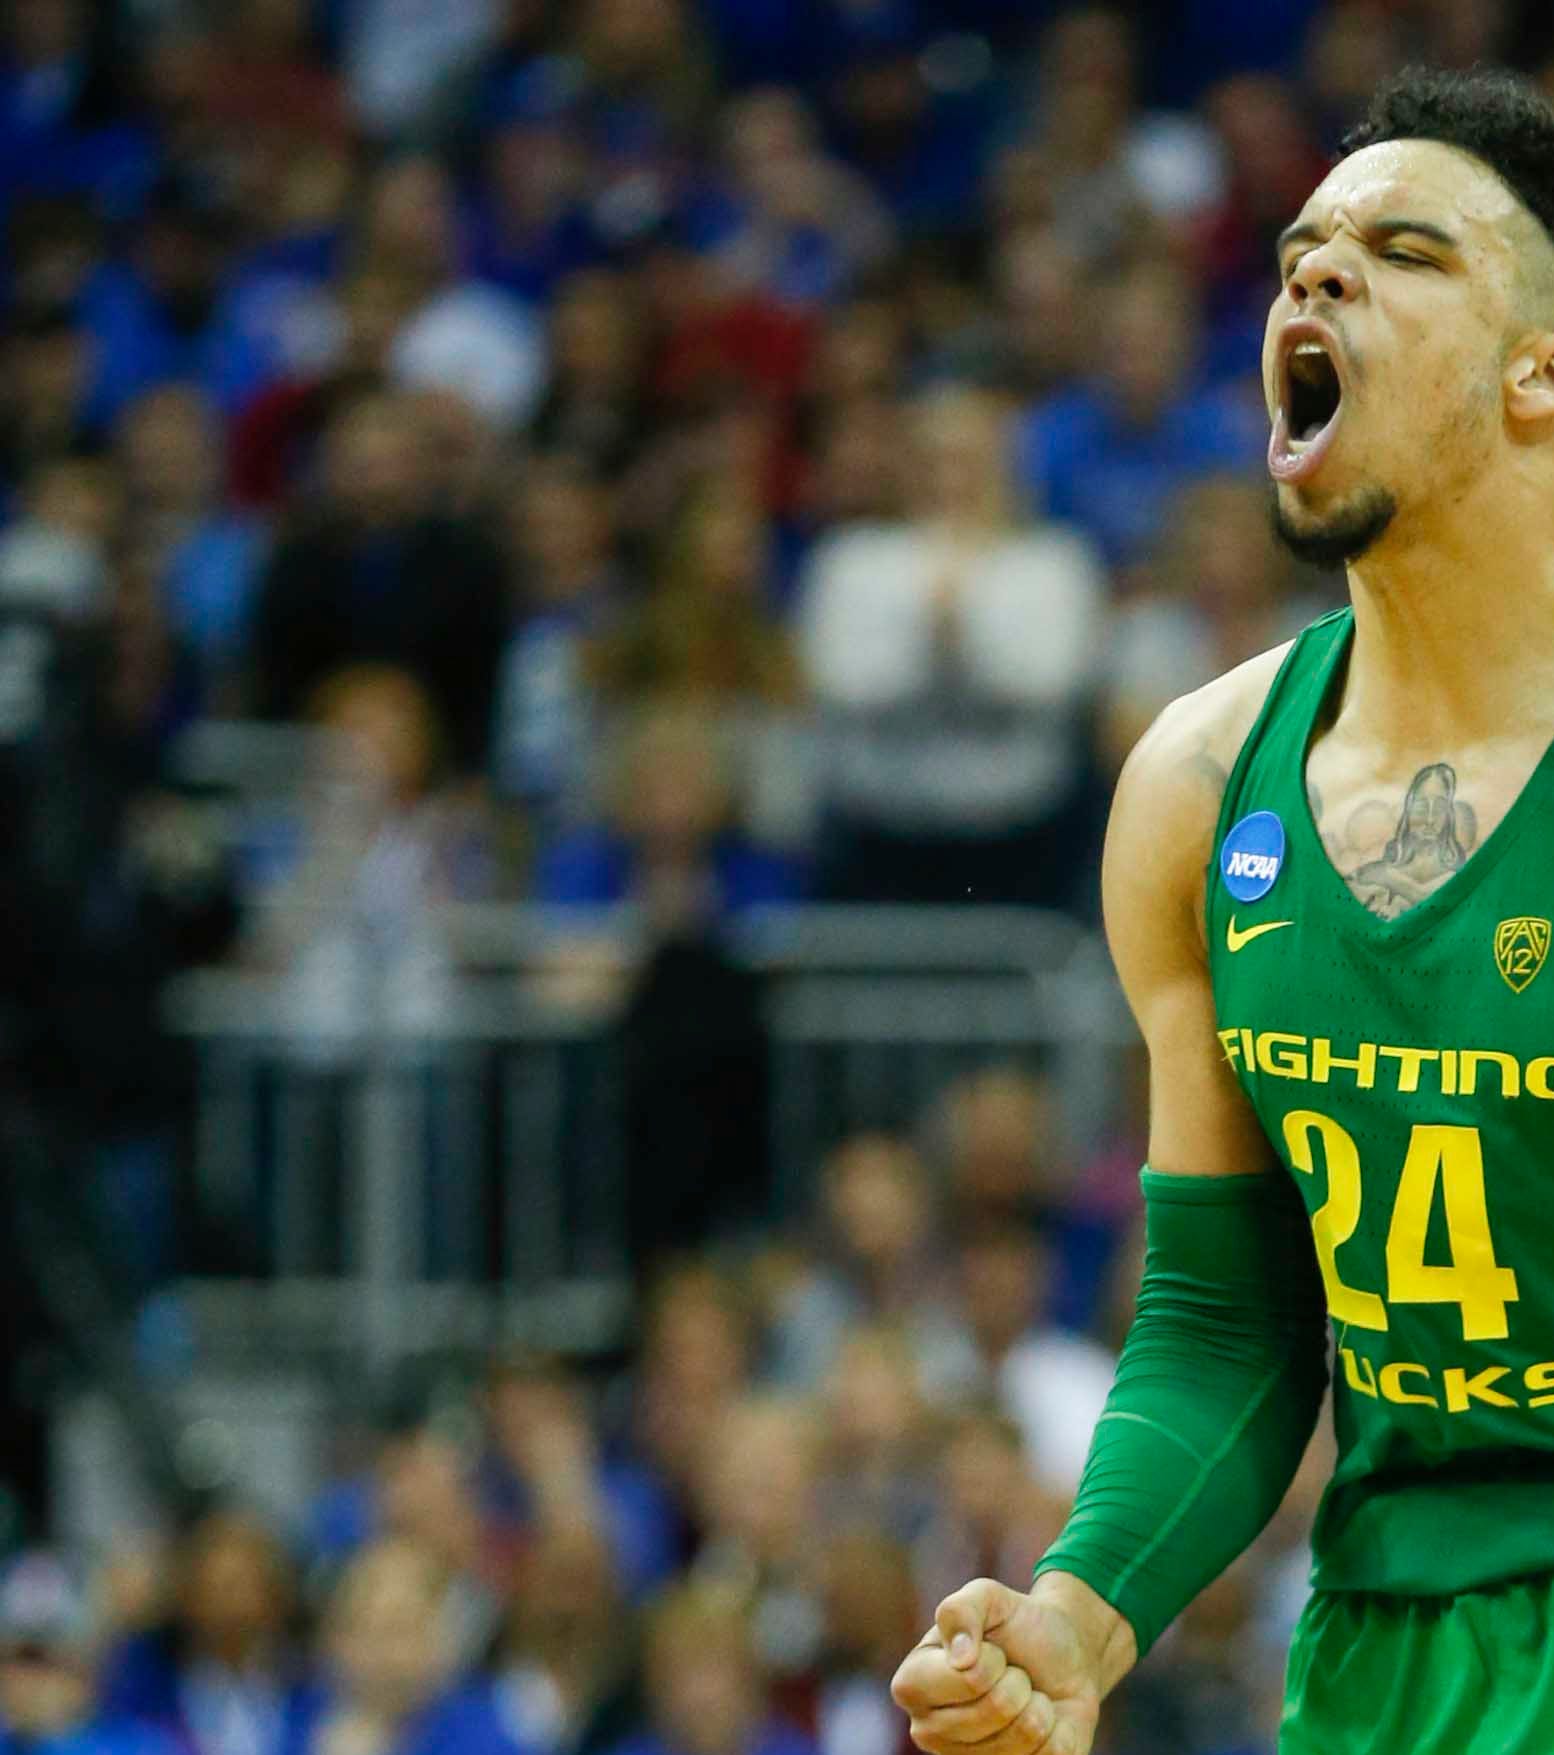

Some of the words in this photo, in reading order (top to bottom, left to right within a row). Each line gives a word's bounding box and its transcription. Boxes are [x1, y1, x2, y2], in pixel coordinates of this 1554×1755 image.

[1227, 852, 1279, 880] NCAA
[1500, 921, 1547, 960] PAC
[1506, 948, 1532, 974] 12
[1283, 1110, 1519, 1341] 24
